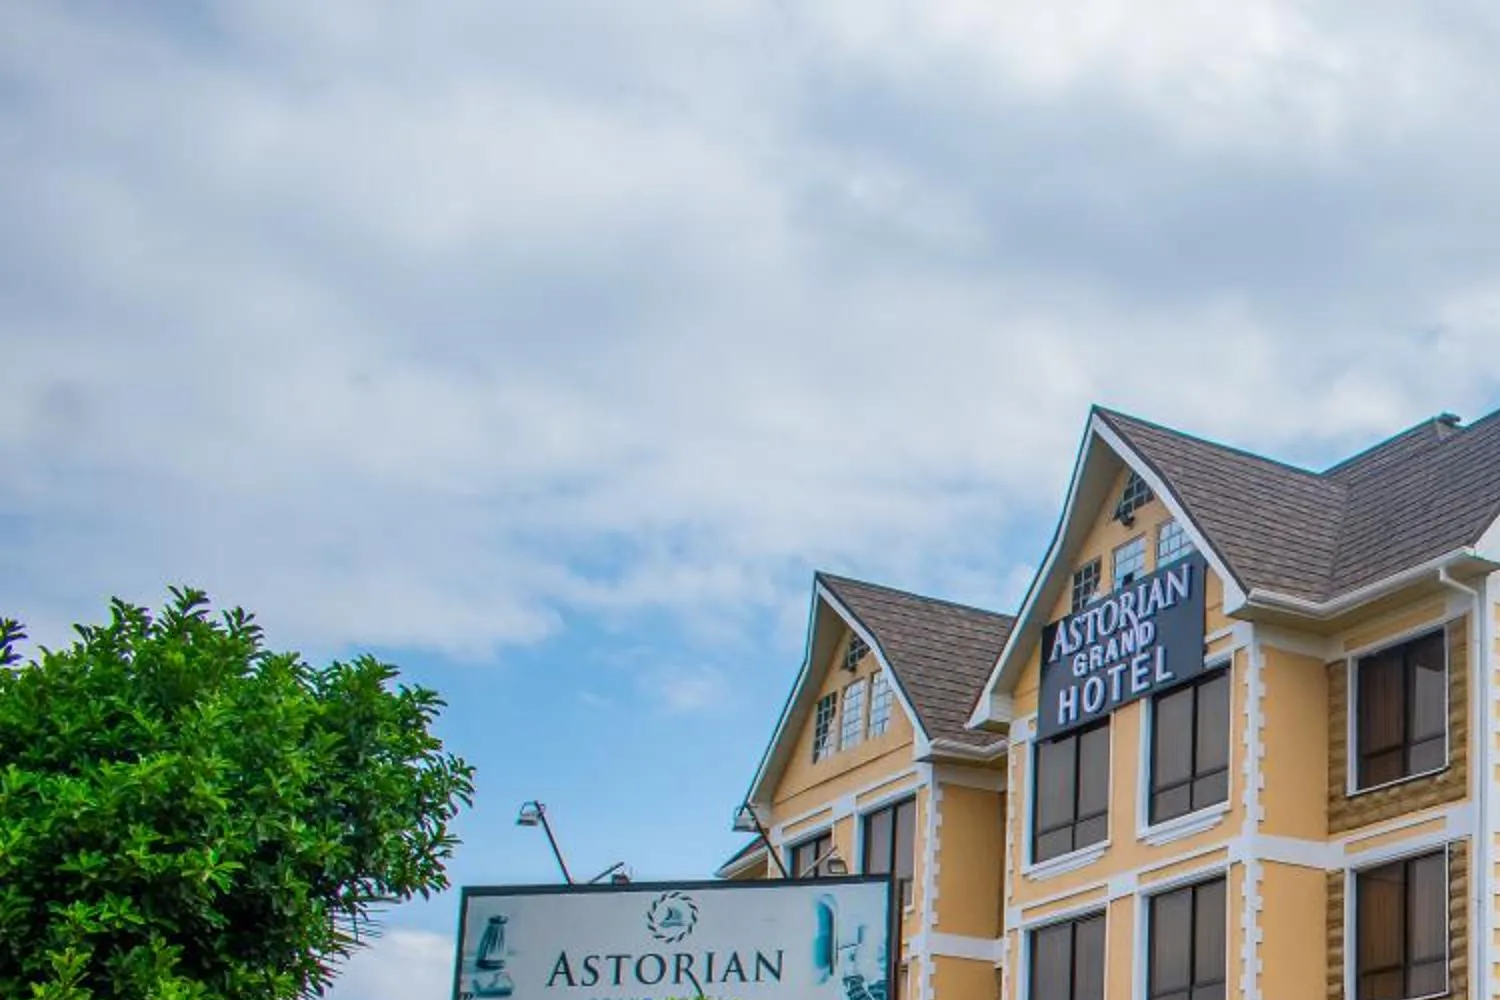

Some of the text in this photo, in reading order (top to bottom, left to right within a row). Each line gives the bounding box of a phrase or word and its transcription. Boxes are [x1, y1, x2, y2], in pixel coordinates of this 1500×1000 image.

[1049, 563, 1192, 662] ASTORIAN
[1073, 621, 1155, 677] GRAND
[1058, 646, 1174, 725] HOTEL
[545, 950, 784, 997] ASTORIAN
